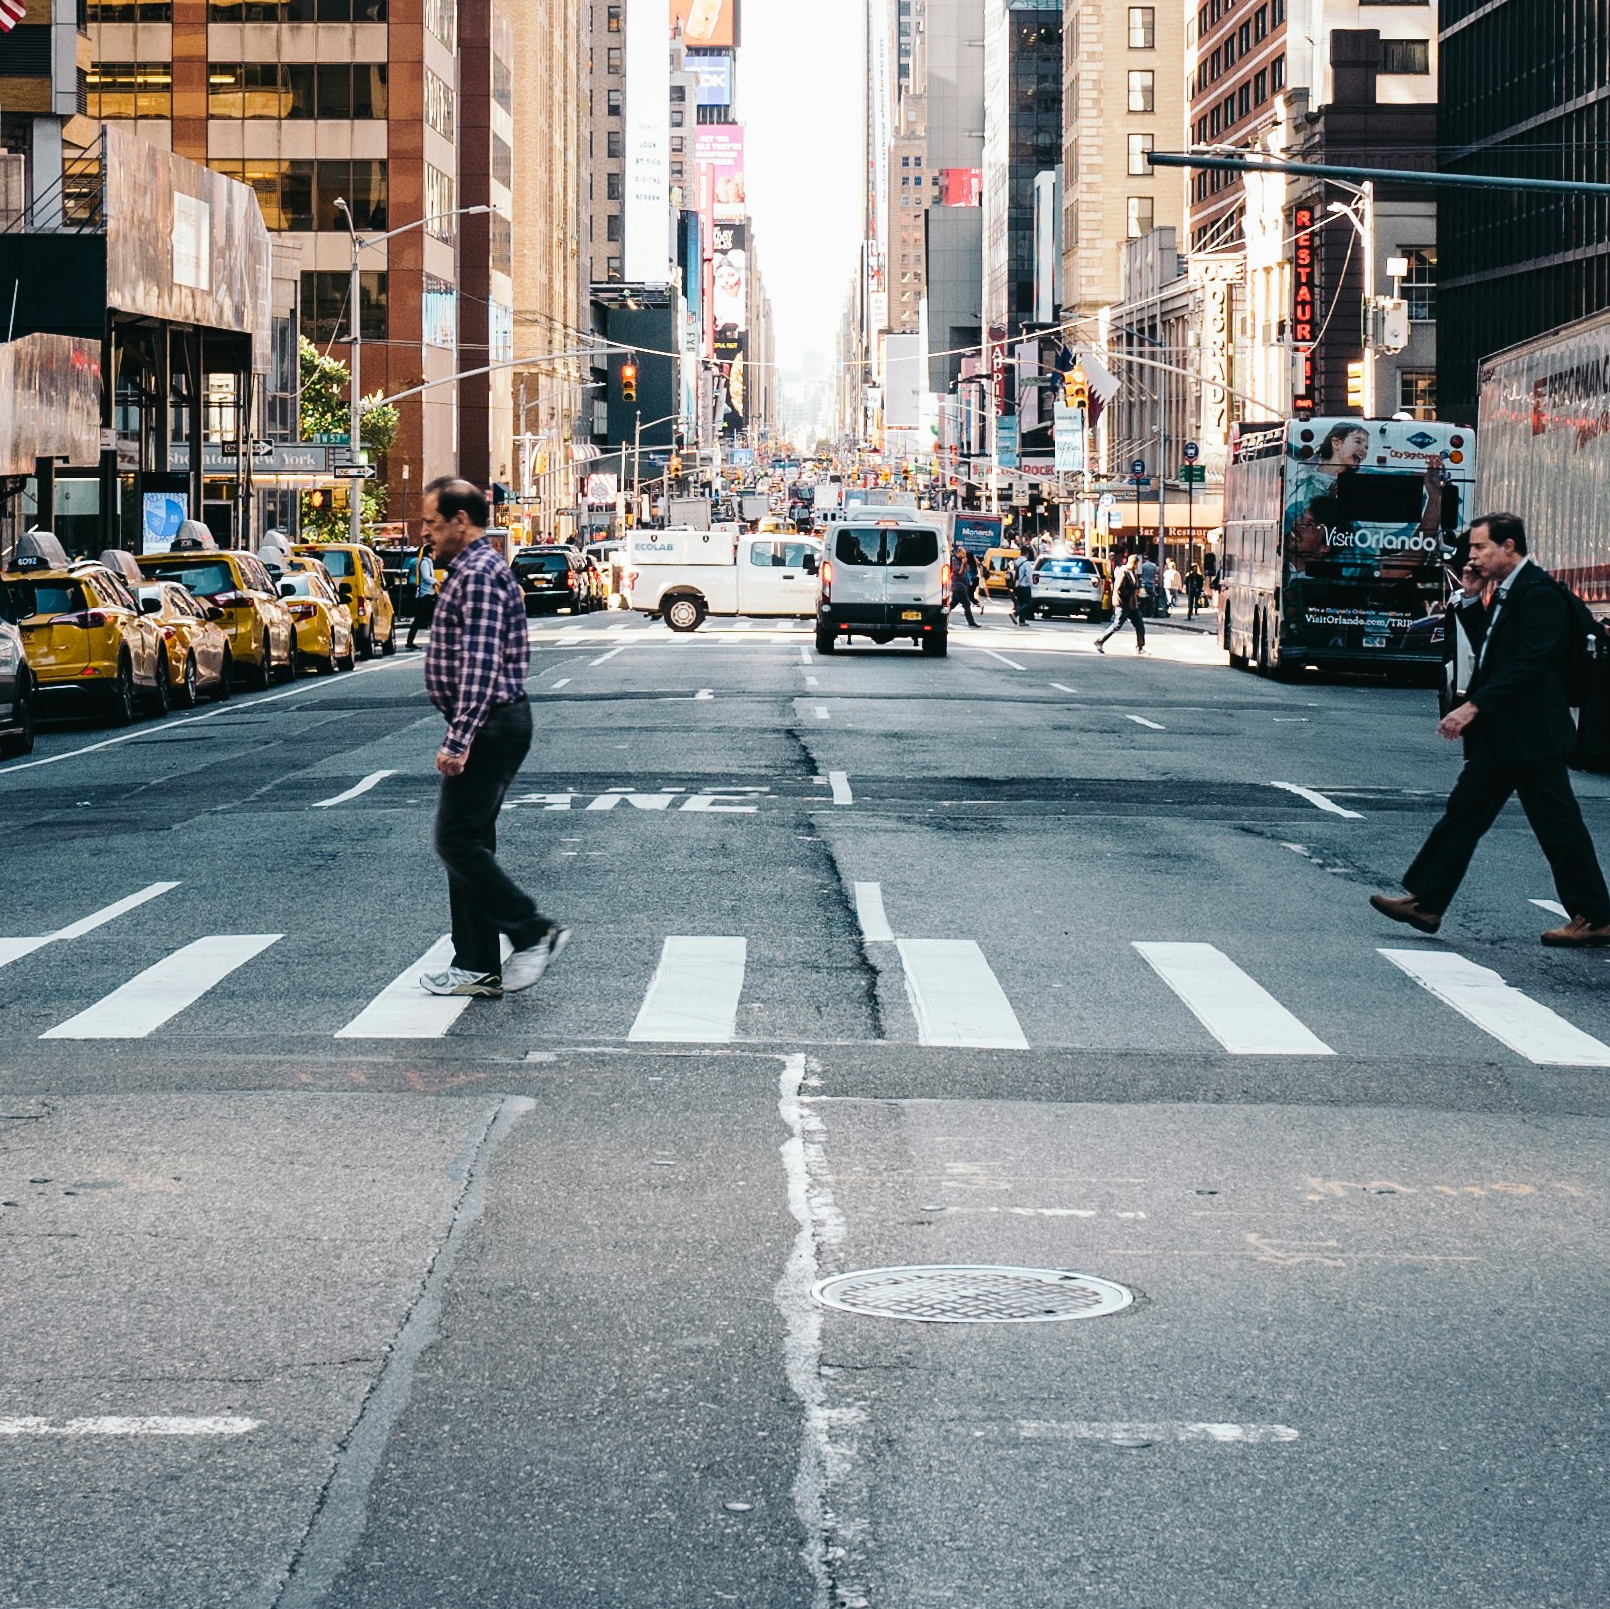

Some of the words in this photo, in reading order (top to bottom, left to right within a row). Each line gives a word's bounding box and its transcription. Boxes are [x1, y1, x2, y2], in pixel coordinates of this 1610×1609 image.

[329, 434, 341, 444] 53
[282, 452, 317, 467] York
[1390, 449, 1403, 462] City
[1014, 489, 1028, 499] 25
[961, 527, 994, 539] Monarch
[634, 542, 674, 552] ECOLAB
